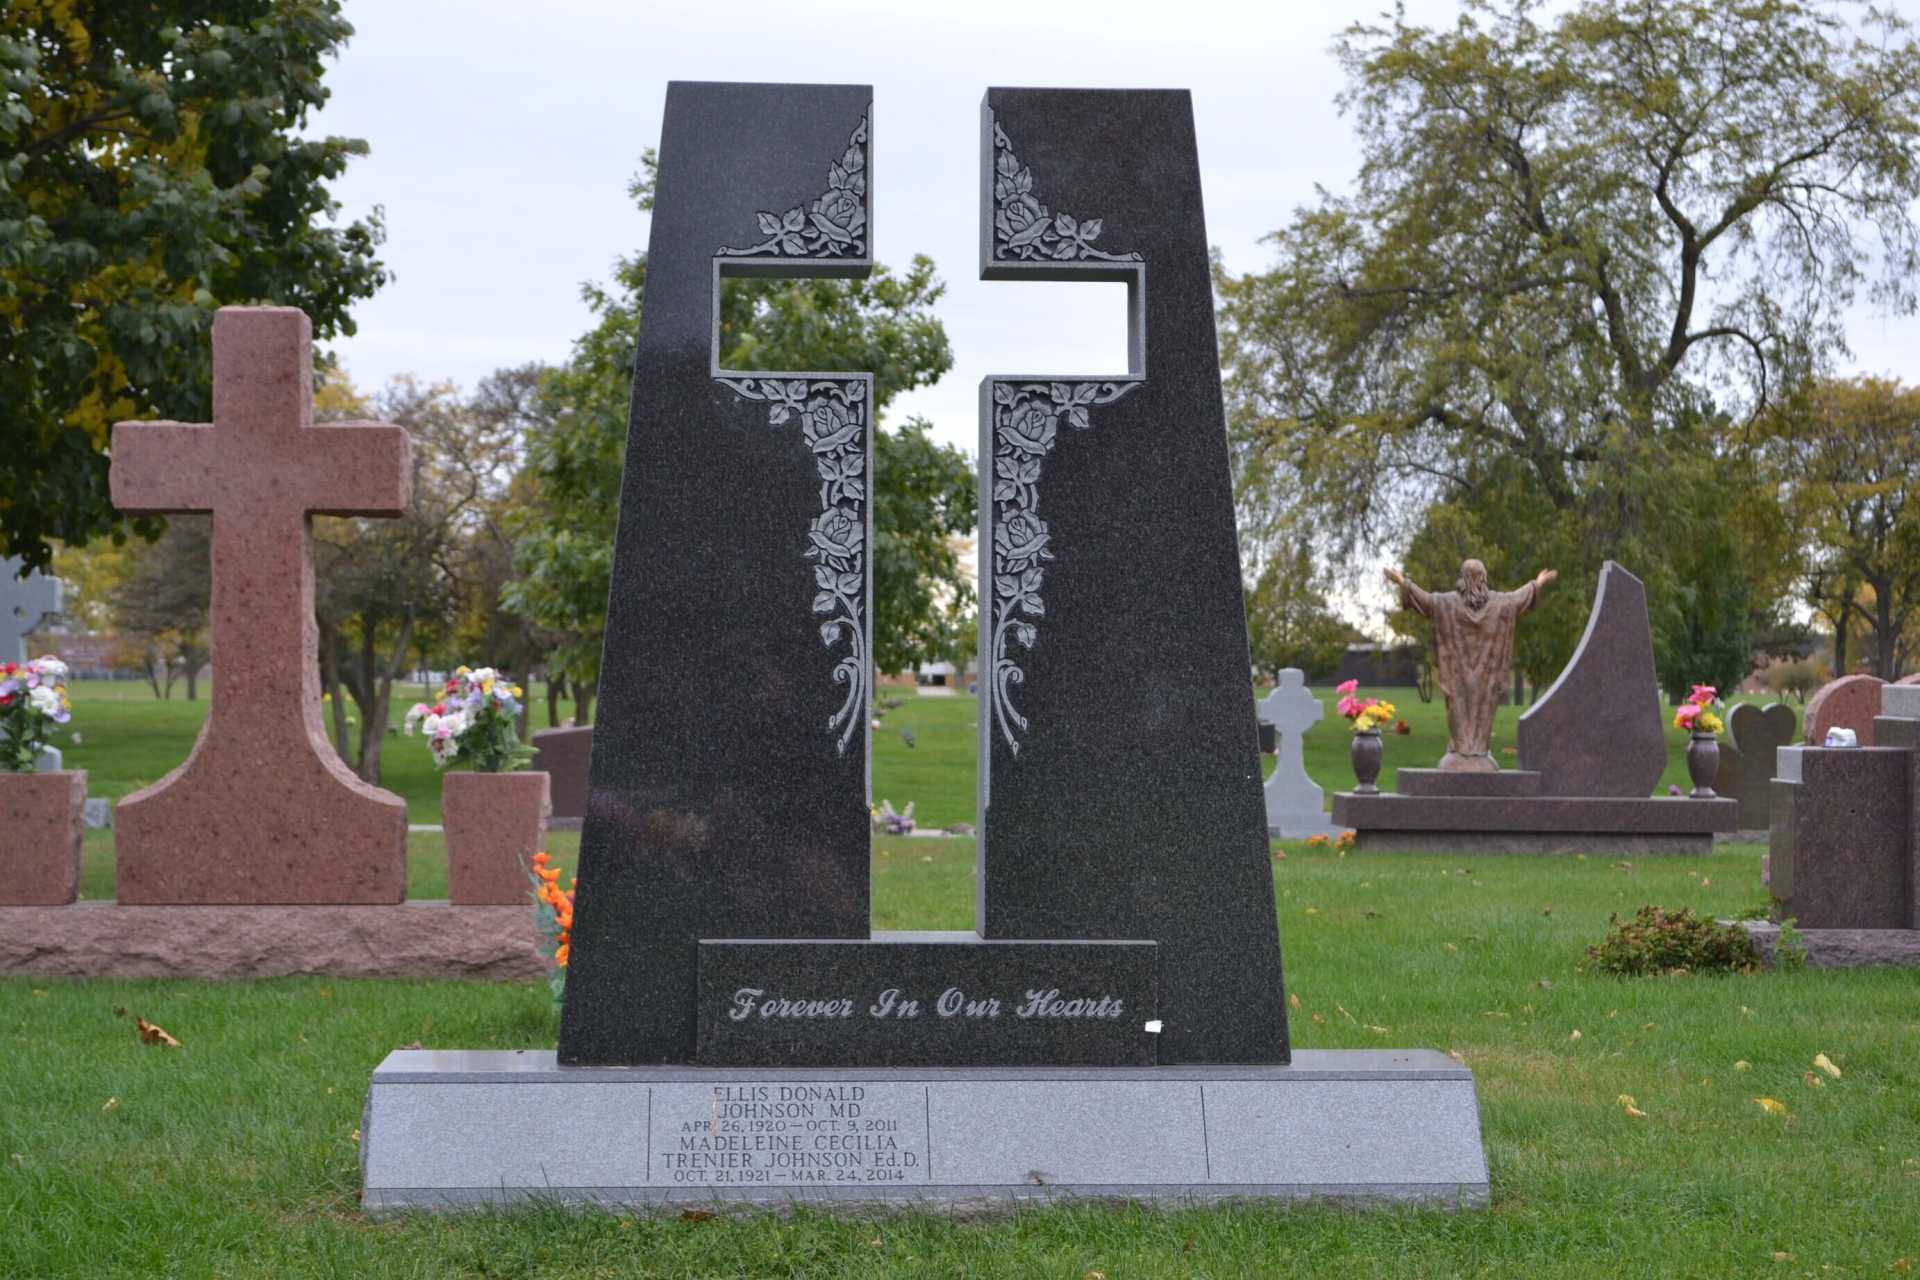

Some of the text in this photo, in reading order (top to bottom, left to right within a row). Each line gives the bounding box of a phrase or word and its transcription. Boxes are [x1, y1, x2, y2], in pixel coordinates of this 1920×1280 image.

[729, 987, 1123, 1020] Forever In Our Hearts
[713, 1086, 865, 1101] ELLIS DONALD
[717, 1103, 861, 1119] JOHNSON MD
[865, 1120, 897, 1132] 2011
[680, 1135, 898, 1151] MADELEINE CECILIA
[663, 1153, 753, 1169] TRENIER
[765, 1151, 861, 1168] JOHNSON
[674, 1170, 708, 1182] OCT.
[866, 1169, 905, 1181] 2014
